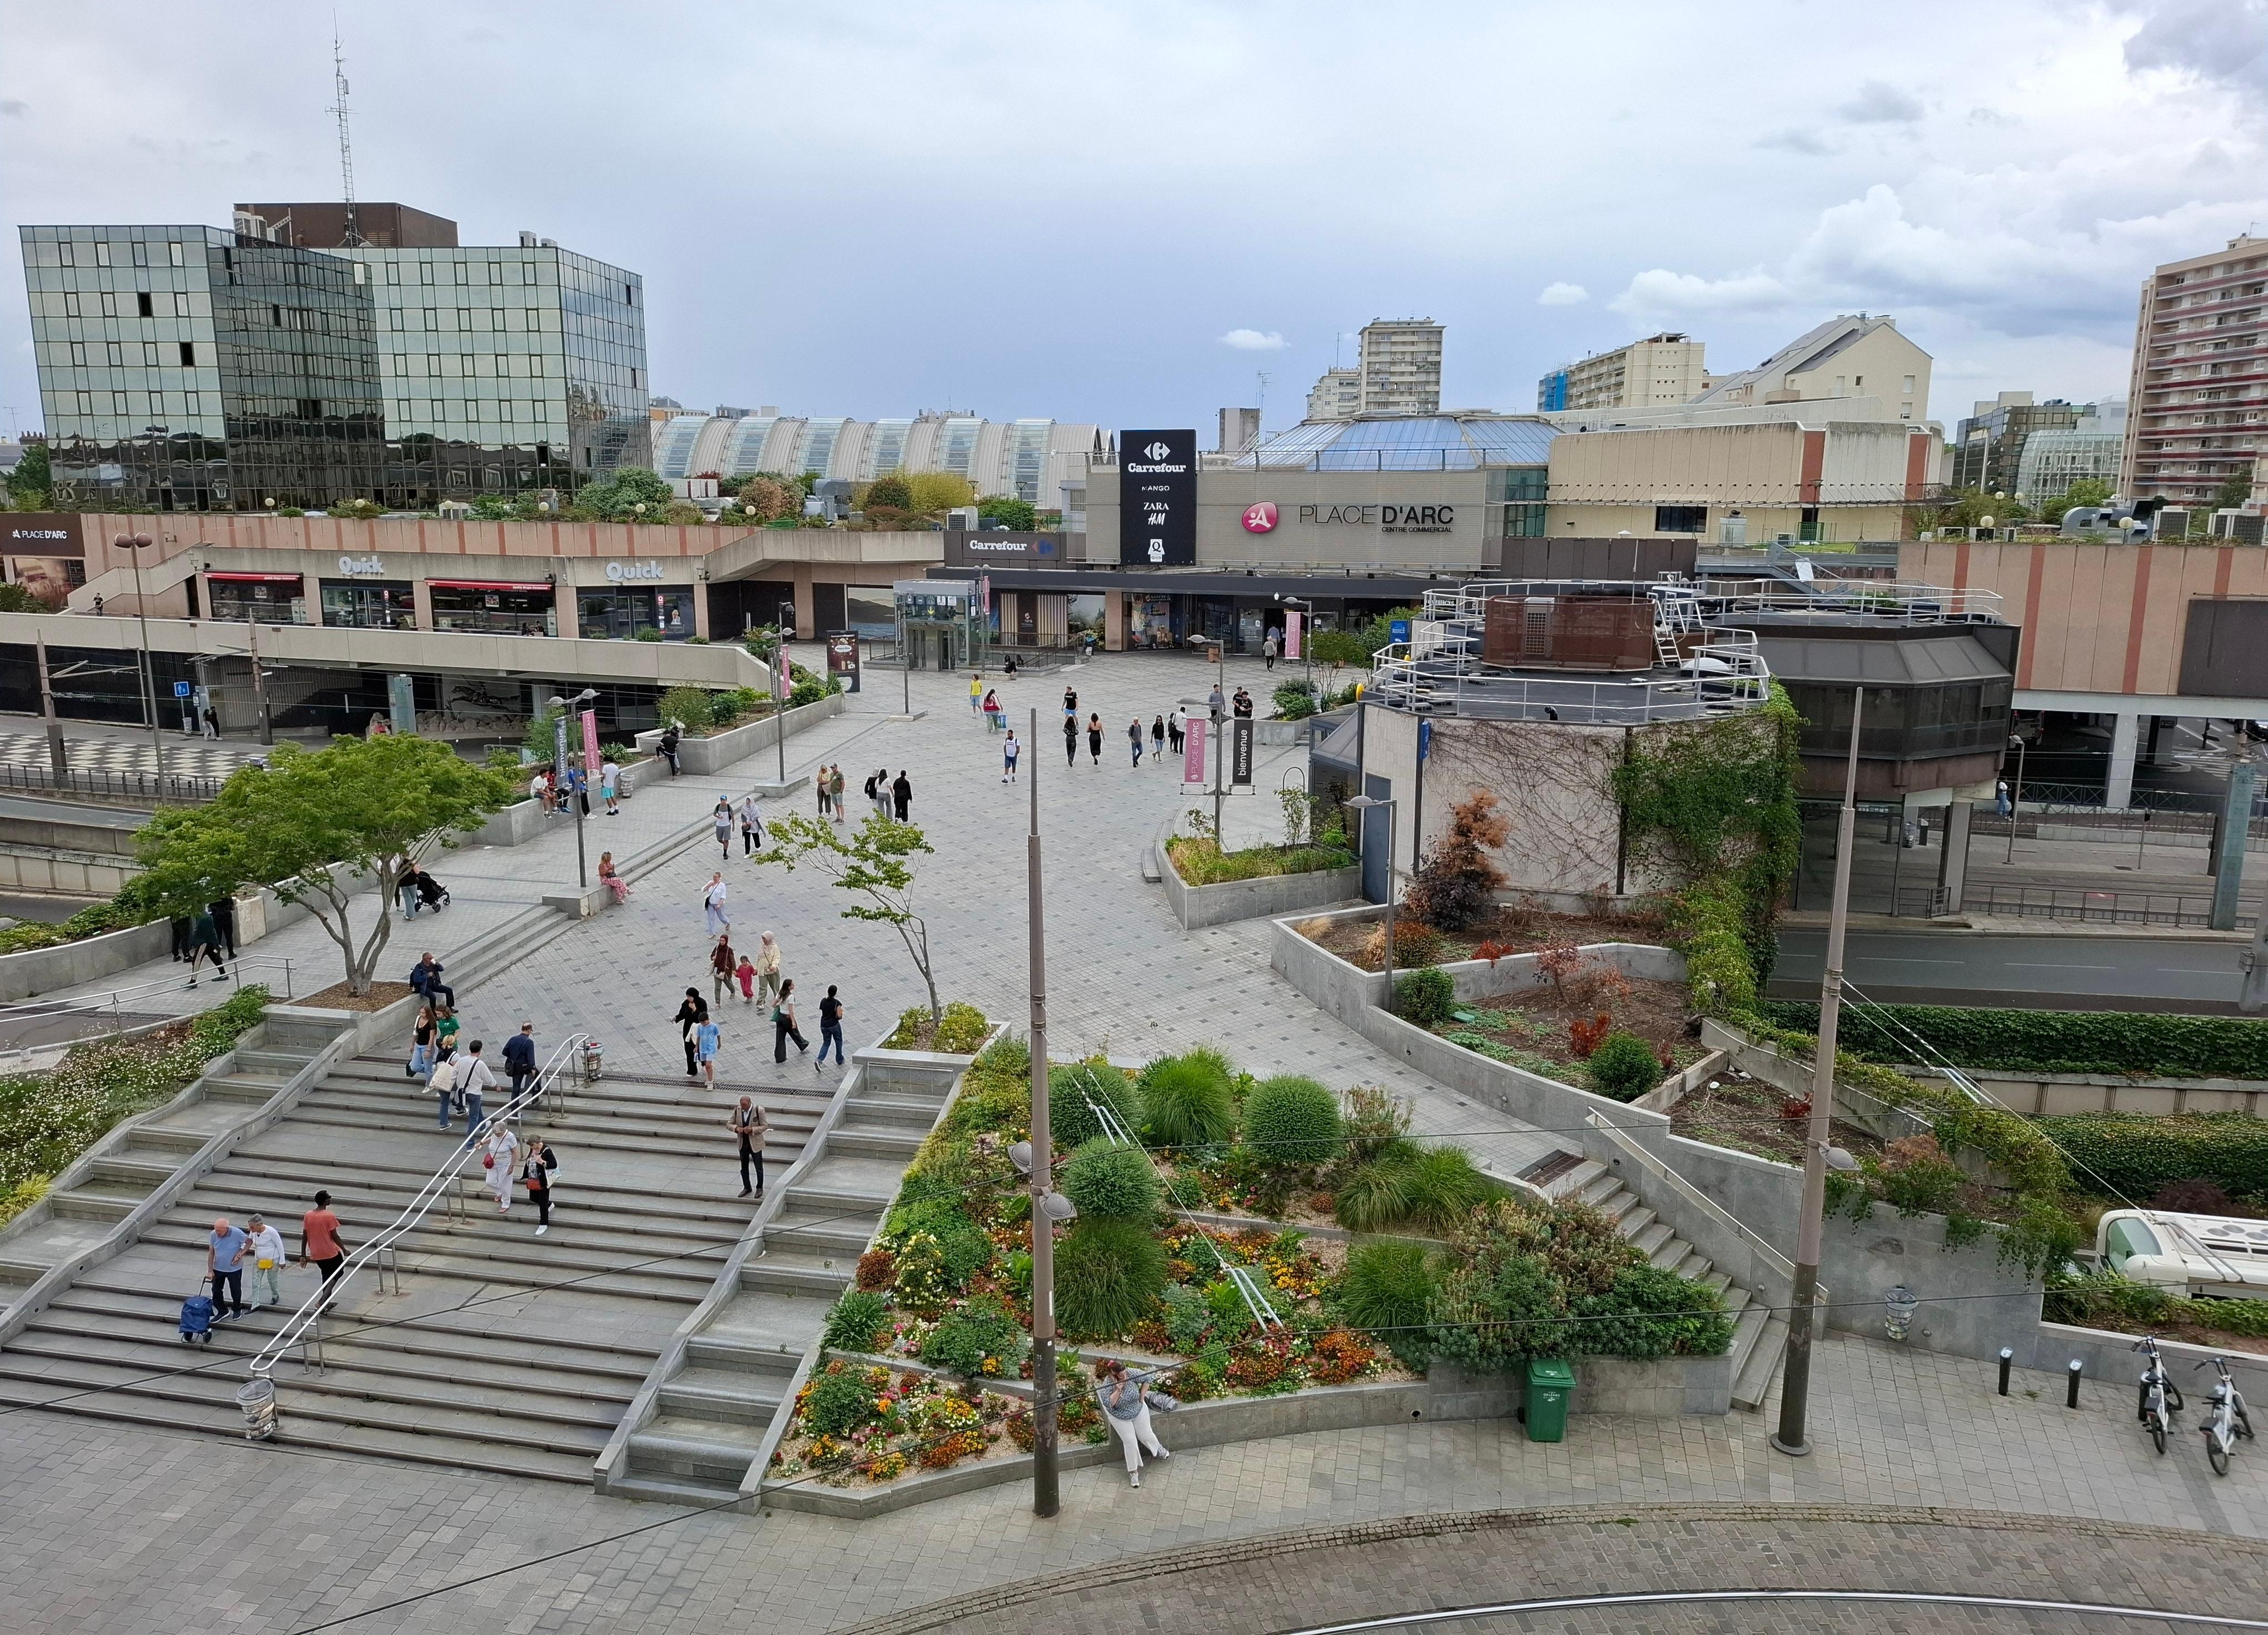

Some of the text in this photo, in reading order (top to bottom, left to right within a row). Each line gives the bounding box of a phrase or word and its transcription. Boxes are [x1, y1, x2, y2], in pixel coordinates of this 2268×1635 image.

[1128, 463, 1186, 473] Carrefour
[1299, 505, 1376, 524] PLACE
[1381, 505, 1454, 524] D'ARC
[44, 530, 67, 539] D'ARC
[969, 540, 1027, 550] Carrefour
[339, 555, 385, 575] Quick
[606, 560, 664, 582] Quick
[1238, 729, 1247, 776] bienvenue
